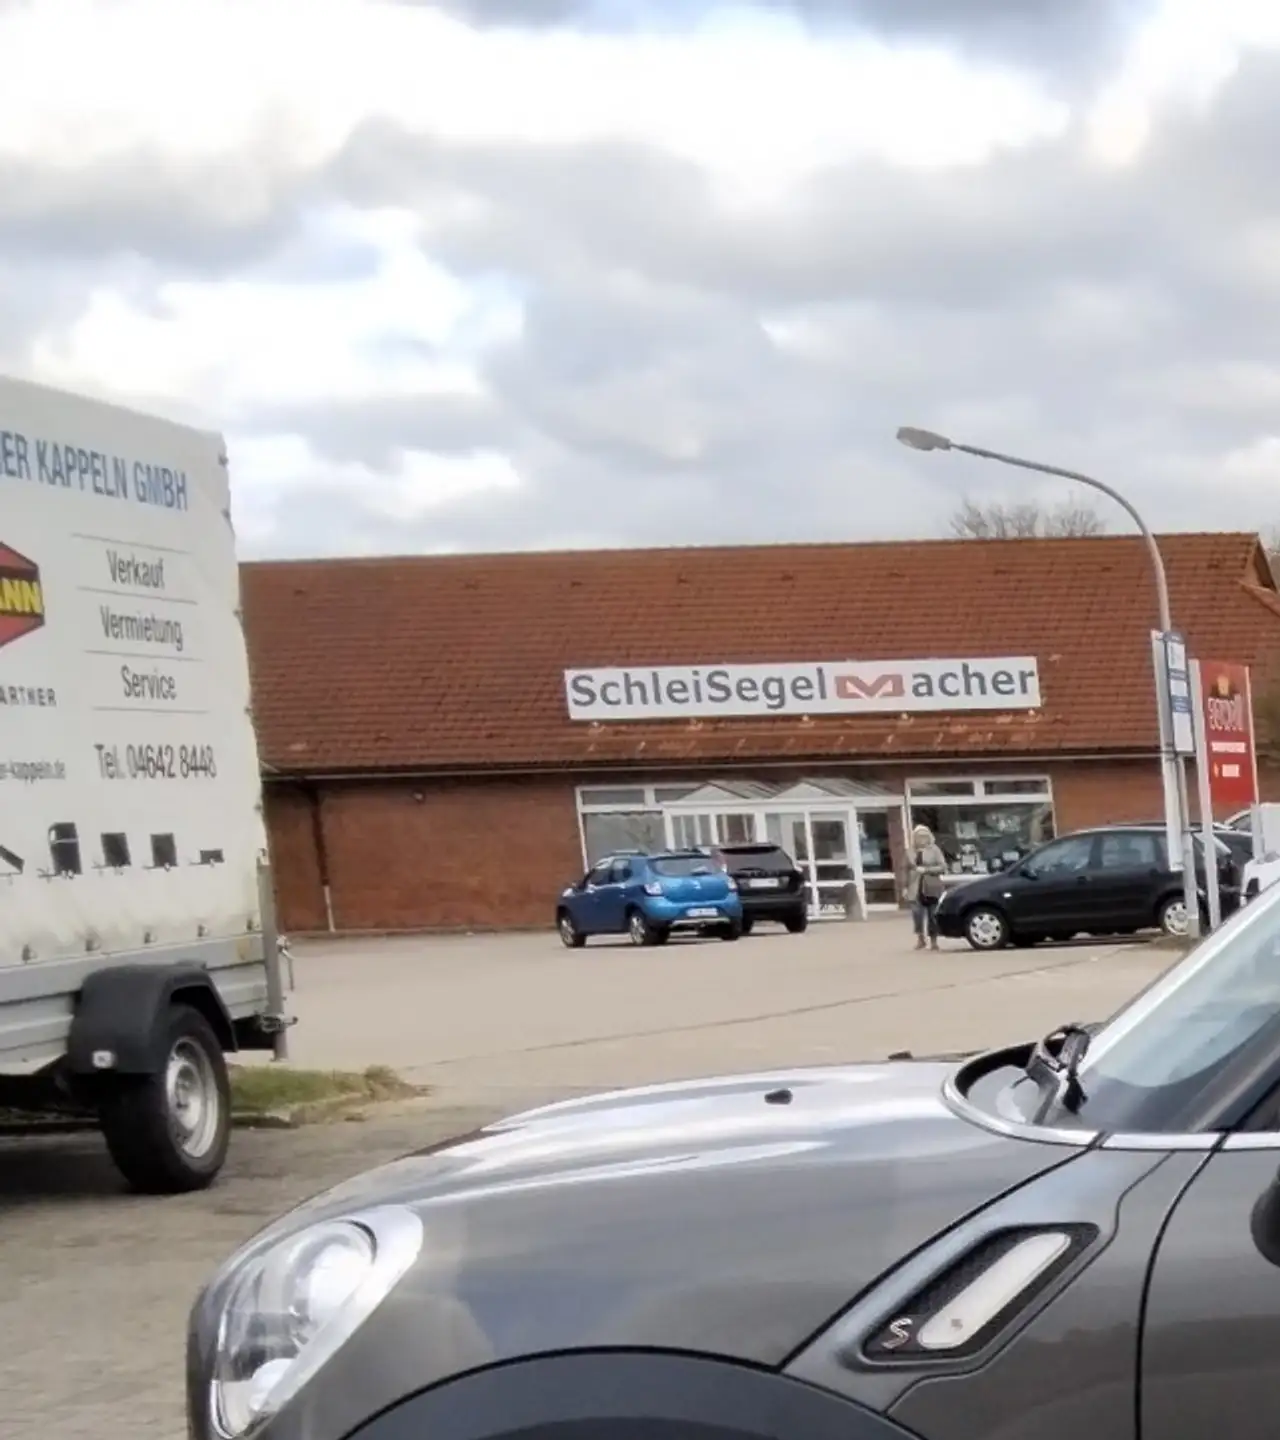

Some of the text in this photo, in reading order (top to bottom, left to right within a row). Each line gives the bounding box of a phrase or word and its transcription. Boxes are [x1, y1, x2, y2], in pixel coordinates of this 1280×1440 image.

[0, 430, 188, 511] ER KAPPELN GMBH
[106, 549, 165, 589] Verkauf
[100, 605, 183, 652] Vermietung
[121, 664, 177, 700] Service
[93, 744, 217, 779] Tel. 04642 8448
[881, 1317, 913, 1350] S
